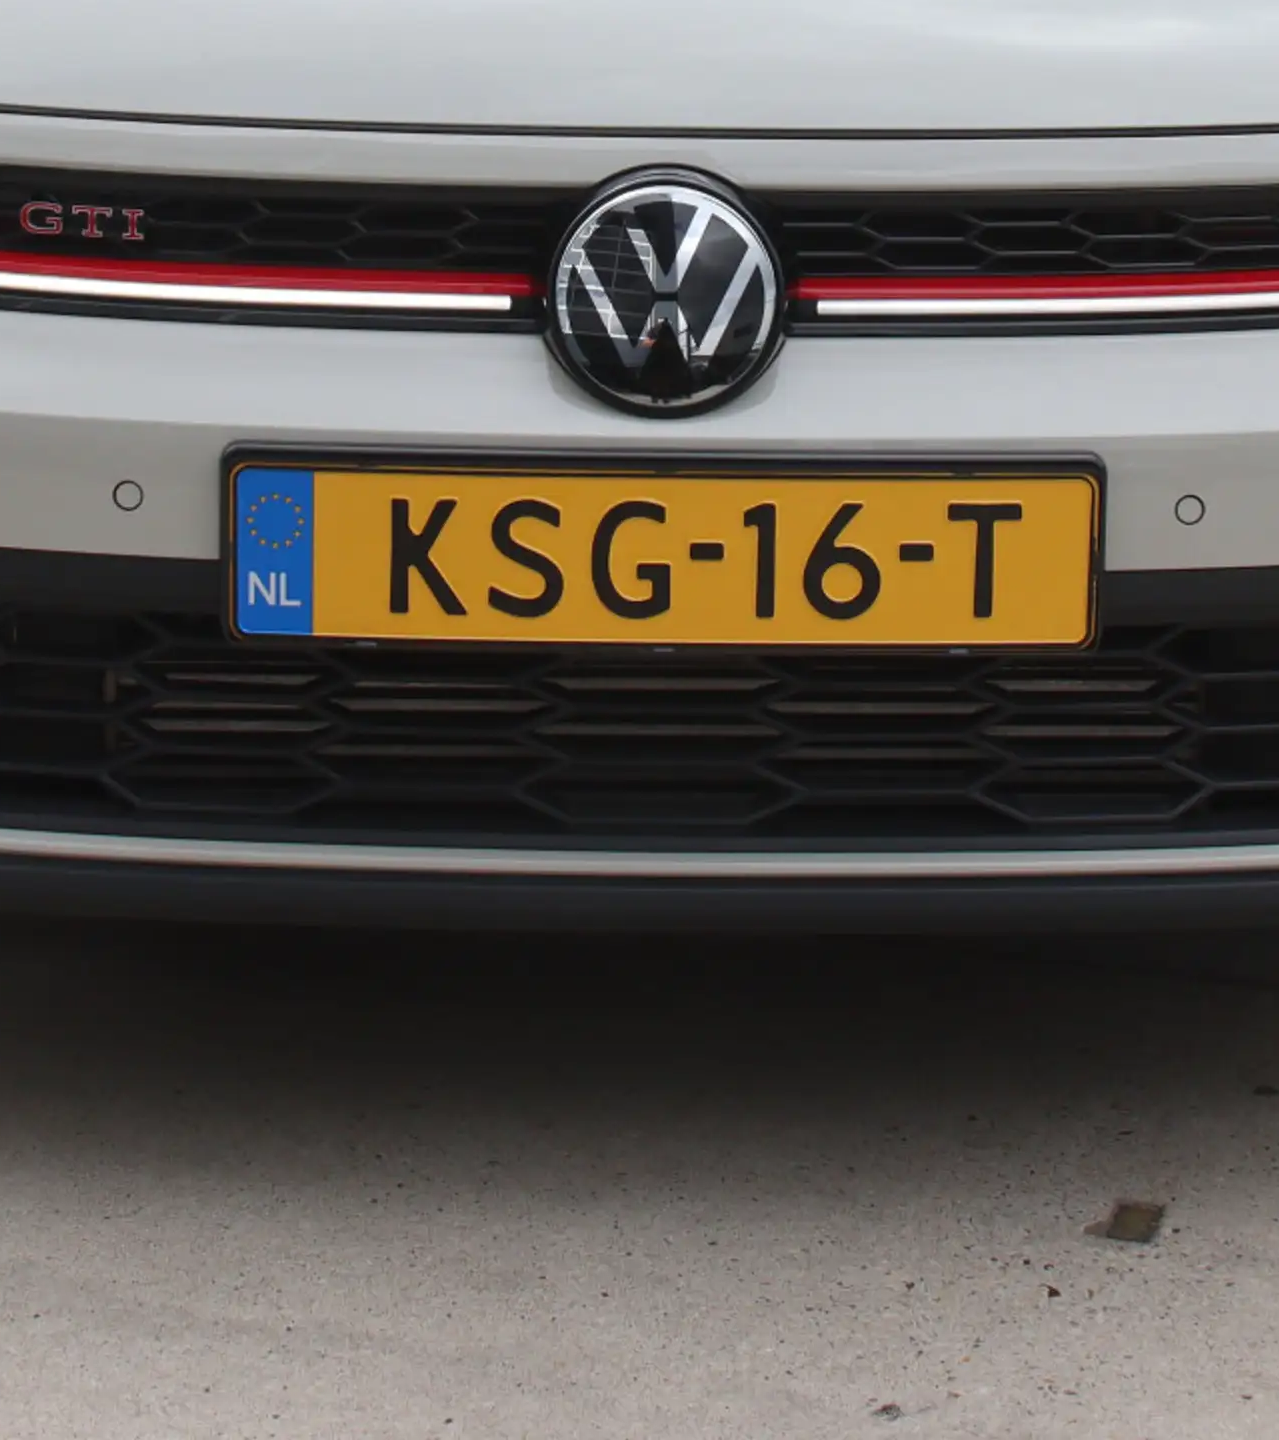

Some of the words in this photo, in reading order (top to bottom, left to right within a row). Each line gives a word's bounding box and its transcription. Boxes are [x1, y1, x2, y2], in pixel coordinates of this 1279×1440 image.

[20, 201, 145, 240] GTI
[389, 496, 1023, 620] KSG-16-T
[247, 570, 302, 607] NL
